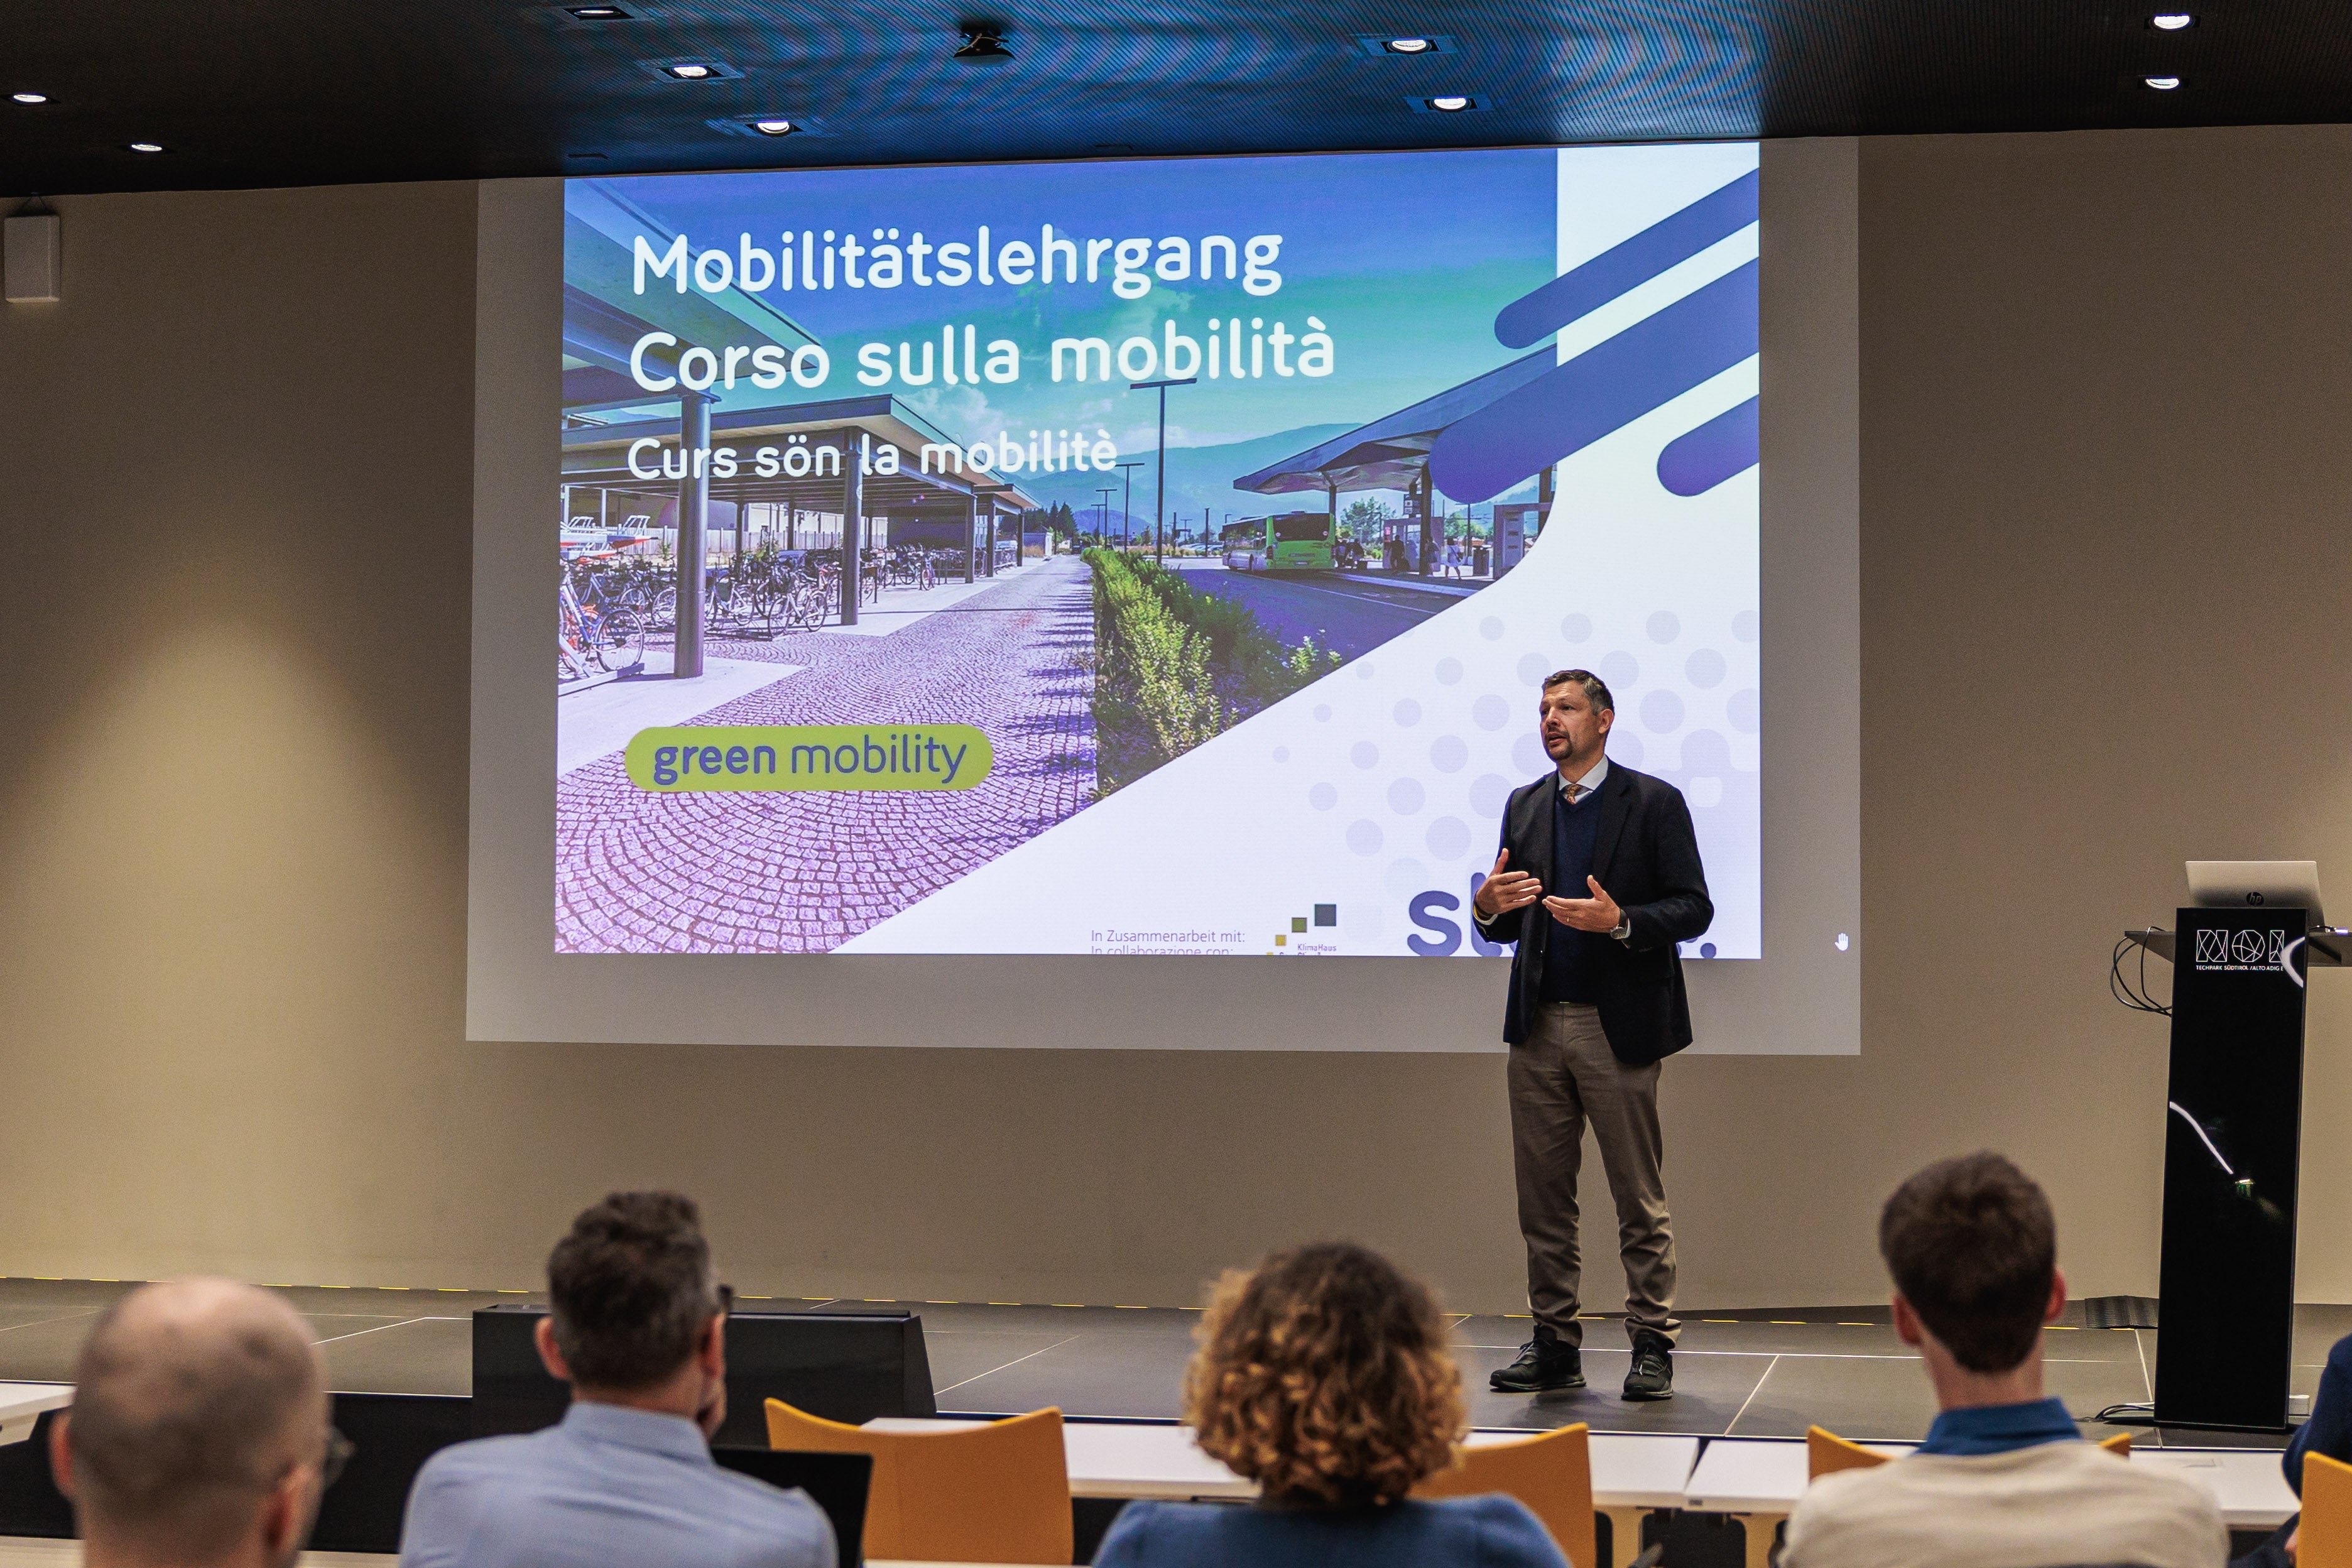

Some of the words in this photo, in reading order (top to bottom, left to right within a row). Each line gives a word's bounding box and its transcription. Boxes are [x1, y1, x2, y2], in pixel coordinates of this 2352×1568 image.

[633, 224, 1283, 300] Mobilitätslehrgang
[630, 331, 830, 392] Corso
[857, 324, 1020, 386] sulla
[1051, 315, 1334, 383] mobilità
[628, 437, 738, 481] Curs
[754, 434, 841, 477] sön
[861, 433, 900, 476] la
[920, 428, 1118, 475] mobilitè
[653, 745, 776, 786] green
[791, 734, 967, 783] mobility
[2248, 892, 2263, 906] hp
[1091, 930, 1102, 942] In
[1107, 929, 1216, 942] Zusammenarbeit
[1221, 930, 1246, 942] mit:
[1297, 943, 1337, 952] KlimaHaus
